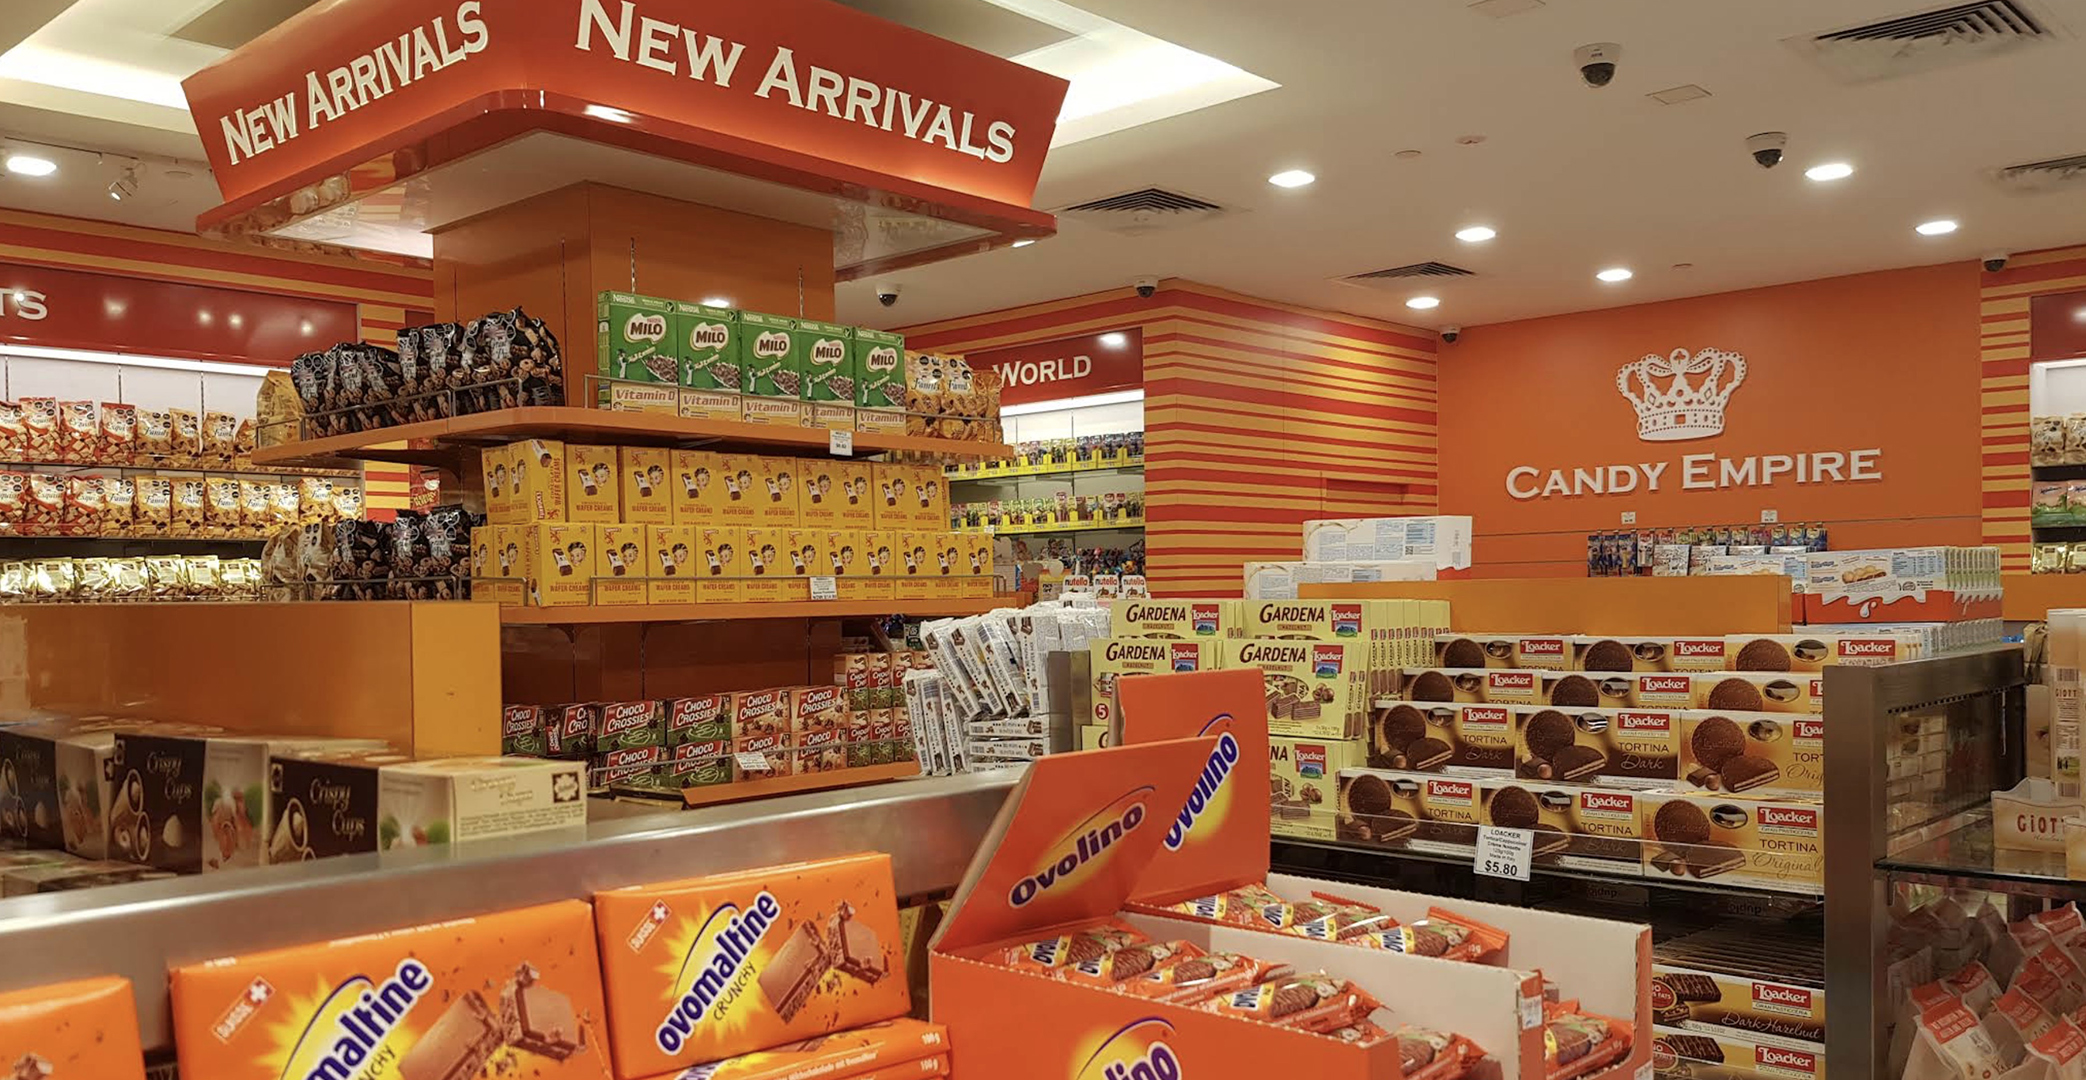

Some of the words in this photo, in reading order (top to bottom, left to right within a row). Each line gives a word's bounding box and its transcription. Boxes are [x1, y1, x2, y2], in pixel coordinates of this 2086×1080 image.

[219, 88, 299, 166] NEW
[304, 1, 489, 131] ARRIVALS
[574, 0, 746, 89] NEW
[755, 45, 1016, 164] ARRIVALS
[992, 355, 1092, 387] WORLD
[615, 388, 666, 401] Vitamin
[683, 395, 730, 406] Vitamin
[745, 401, 790, 412] Vitamin
[860, 412, 898, 422] Vitamin
[1505, 461, 1668, 500] CANDY
[1681, 448, 1883, 490] EMPIRE
[1064, 578, 1088, 586] nutella
[1095, 577, 1118, 586] nutella
[1126, 604, 1186, 623] GARDENA
[1259, 603, 1325, 623] GARDENA
[1105, 643, 1165, 661] GARDENA
[1239, 643, 1307, 663] GARDENA
[1521, 641, 1561, 652] Loacker
[1675, 642, 1721, 655] Loacker
[1840, 640, 1892, 655] Loacker
[1491, 673, 1531, 686] Loacker
[1641, 677, 1686, 691] Loacker
[747, 694, 772, 707] CHOCO
[807, 690, 832, 703] CHOCO
[616, 703, 645, 719] CHOCO
[684, 699, 713, 713] CHOCO
[740, 702, 777, 720] CROSSIES
[800, 699, 836, 715] CROSSIES
[1464, 708, 1505, 720] Loacker
[607, 712, 649, 732] CROSSIES
[676, 708, 717, 726] CROSSIES
[1620, 713, 1666, 728] Loacker
[747, 737, 774, 751] CHOCO
[807, 732, 831, 744] CHOCO
[1463, 735, 1507, 744] TORTINA
[686, 742, 714, 758] CHOCO
[1618, 741, 1669, 752] TORTINA
[147, 751, 182, 777] Crispy
[619, 749, 649, 765] CHOCO
[1620, 753, 1665, 770] Dark
[164, 778, 193, 804] Cups
[309, 778, 351, 809] Crispy
[1429, 781, 1470, 795] Loacker
[1582, 793, 1629, 808] Loacker
[1428, 807, 1472, 820] TORTINA
[1760, 808, 1813, 824] Loacker
[332, 808, 366, 841] Cups
[1581, 822, 1633, 836] TORTINA
[1491, 829, 1521, 839] LOACKER
[1759, 839, 1818, 854] TORTINA
[1009, 803, 1145, 907] ovolino
[1485, 860, 1518, 876] $5.80
[1752, 852, 1824, 879] Original
[657, 892, 779, 1055] ovomaltine
[712, 959, 757, 1023] CRUNCHY
[1754, 984, 1807, 1004] Loacker
[305, 961, 430, 1080] maltine
[1721, 1011, 1760, 1030] Dark
[1759, 1018, 1820, 1039] Hazelnut
[1758, 1047, 1812, 1067] Loacker
